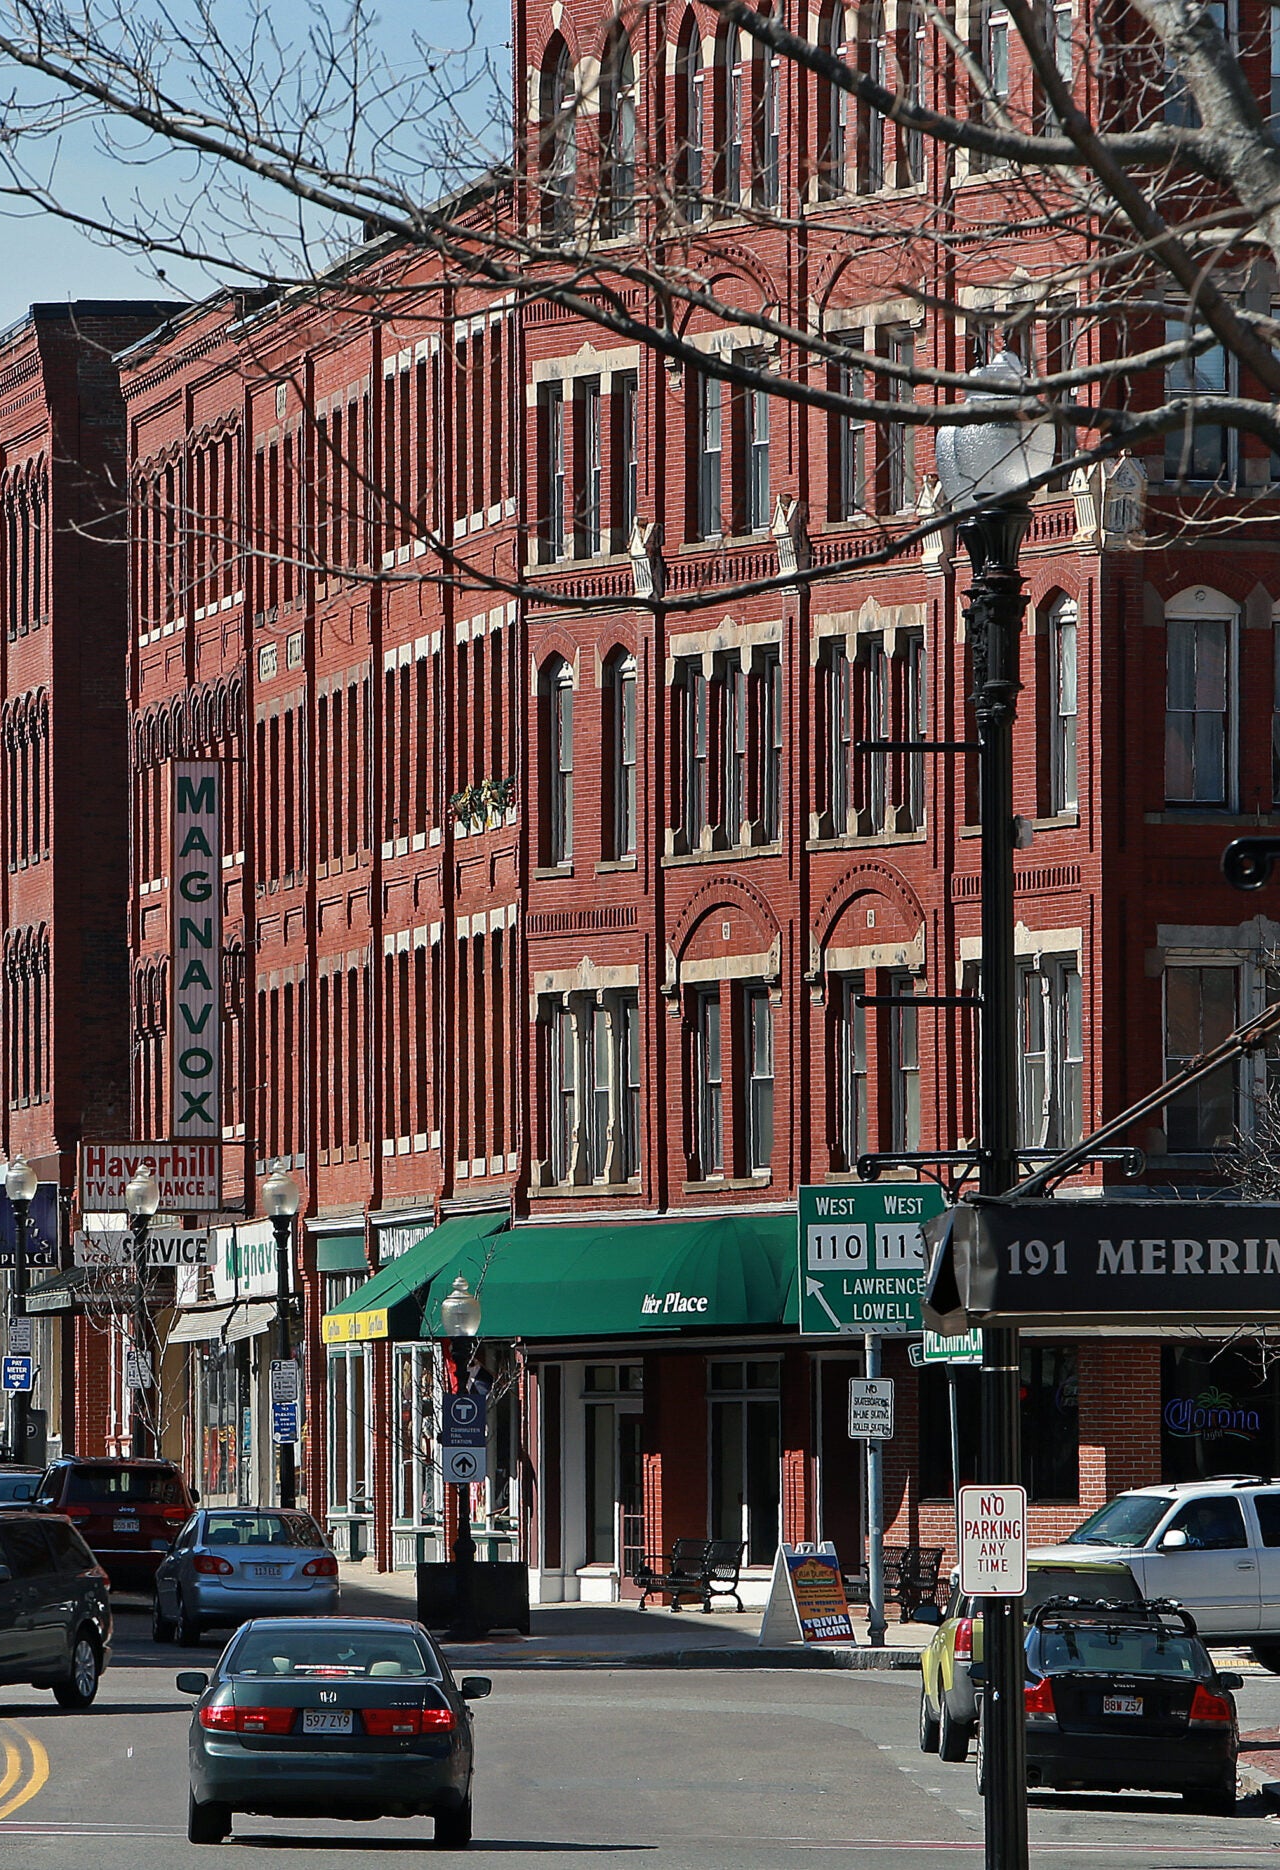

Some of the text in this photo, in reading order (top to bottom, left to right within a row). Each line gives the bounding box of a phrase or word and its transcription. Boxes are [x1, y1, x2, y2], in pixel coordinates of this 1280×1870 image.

[178, 776, 216, 1123] MAGNAVOX
[86, 1146, 215, 1178] Haverhill
[86, 1181, 106, 1197] TV
[108, 1185, 117, 1197] &
[118, 1180, 205, 1197] AIANCE
[815, 1196, 856, 1216] WEST
[883, 1195, 924, 1215] WEST
[122, 1237, 208, 1264] SRVICE
[814, 1234, 862, 1260] 110
[1007, 1239, 1068, 1276] 191
[843, 1277, 927, 1296] LAWRENCE
[662, 1291, 708, 1313] Place
[853, 1302, 915, 1321] LOWELL
[912, 1346, 924, 1364] E
[865, 1384, 878, 1394] NO
[1164, 1398, 1260, 1434] Corona
[980, 1496, 1005, 1517] NO
[964, 1520, 1021, 1540] PARKING
[980, 1542, 1006, 1556] ANY
[977, 1558, 1009, 1573] TIME
[803, 1614, 847, 1629] TRIVIA
[814, 1624, 851, 1638] NIGHT!
[305, 1713, 350, 1728] 597 ZY9
